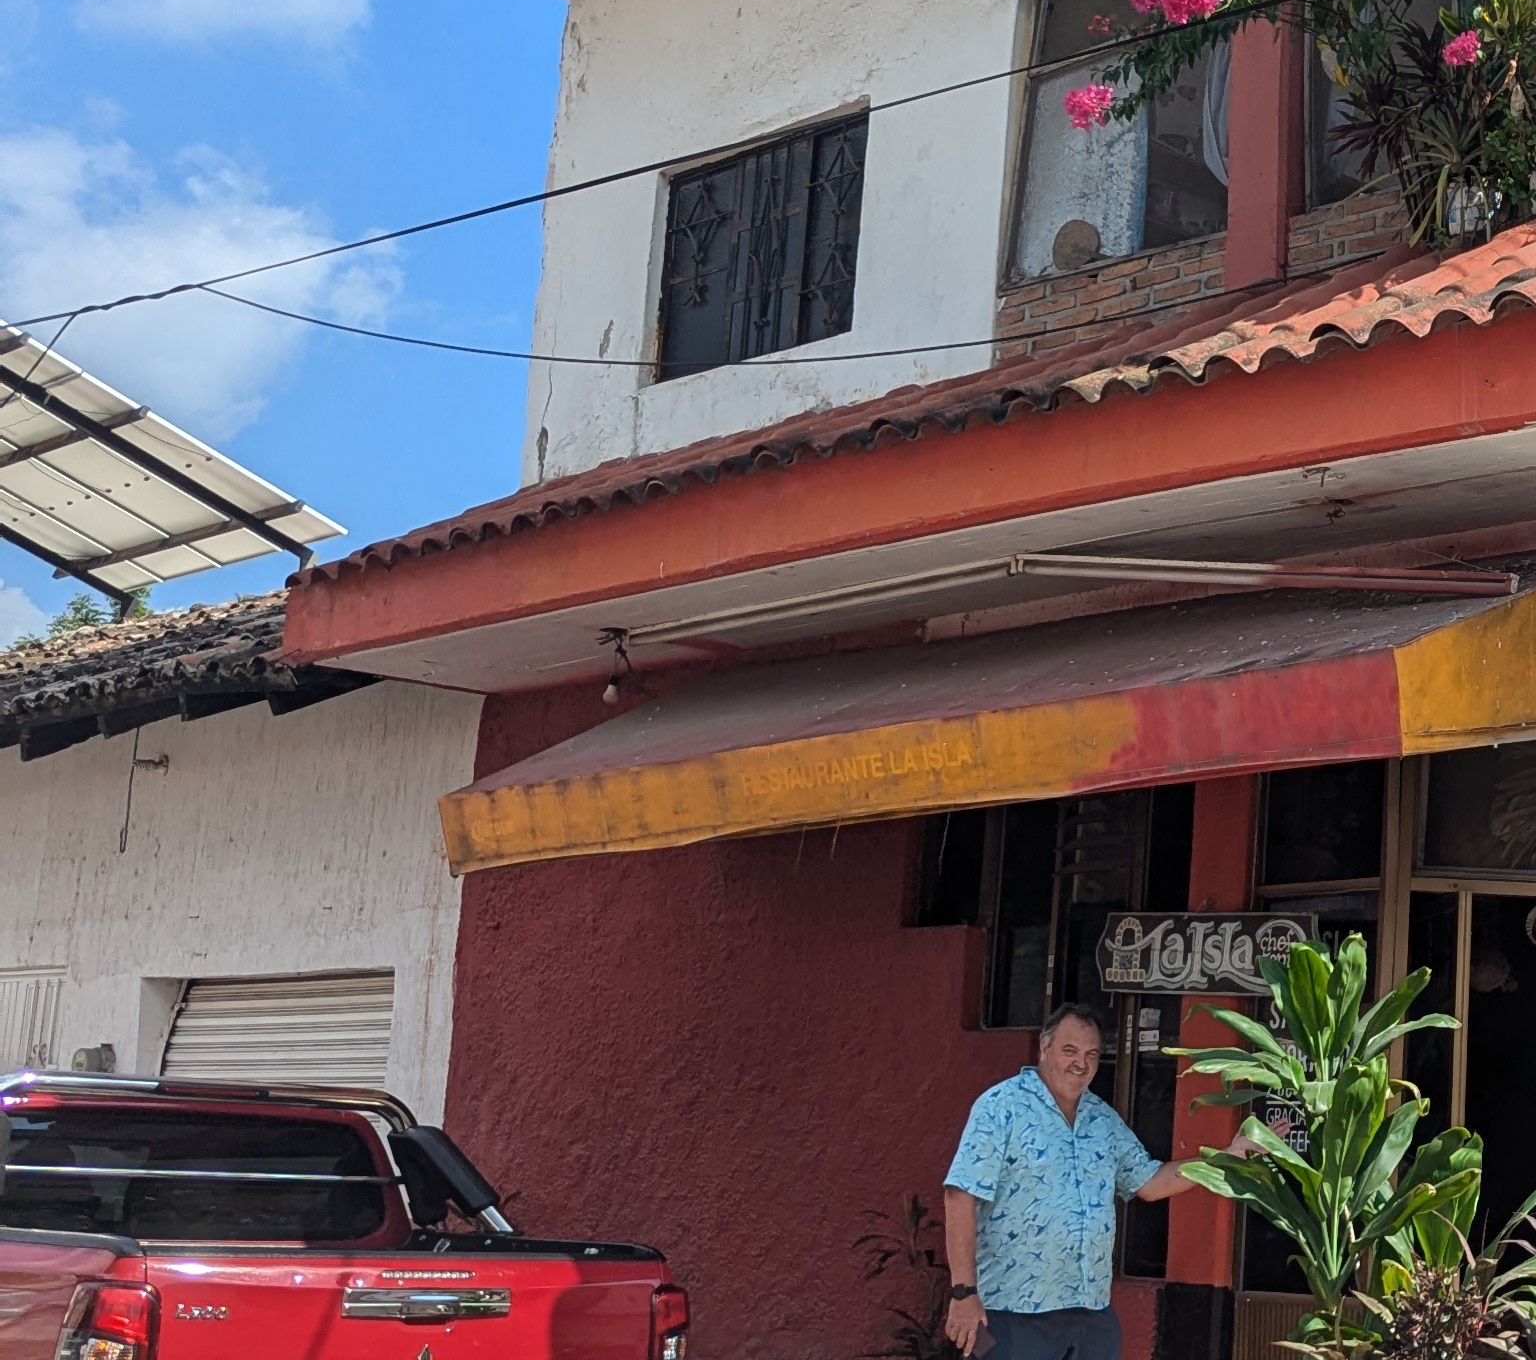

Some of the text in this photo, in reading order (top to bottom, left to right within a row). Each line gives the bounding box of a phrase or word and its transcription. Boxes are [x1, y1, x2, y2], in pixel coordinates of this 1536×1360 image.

[742, 740, 973, 796] RESTAURANTE LA ISLA
